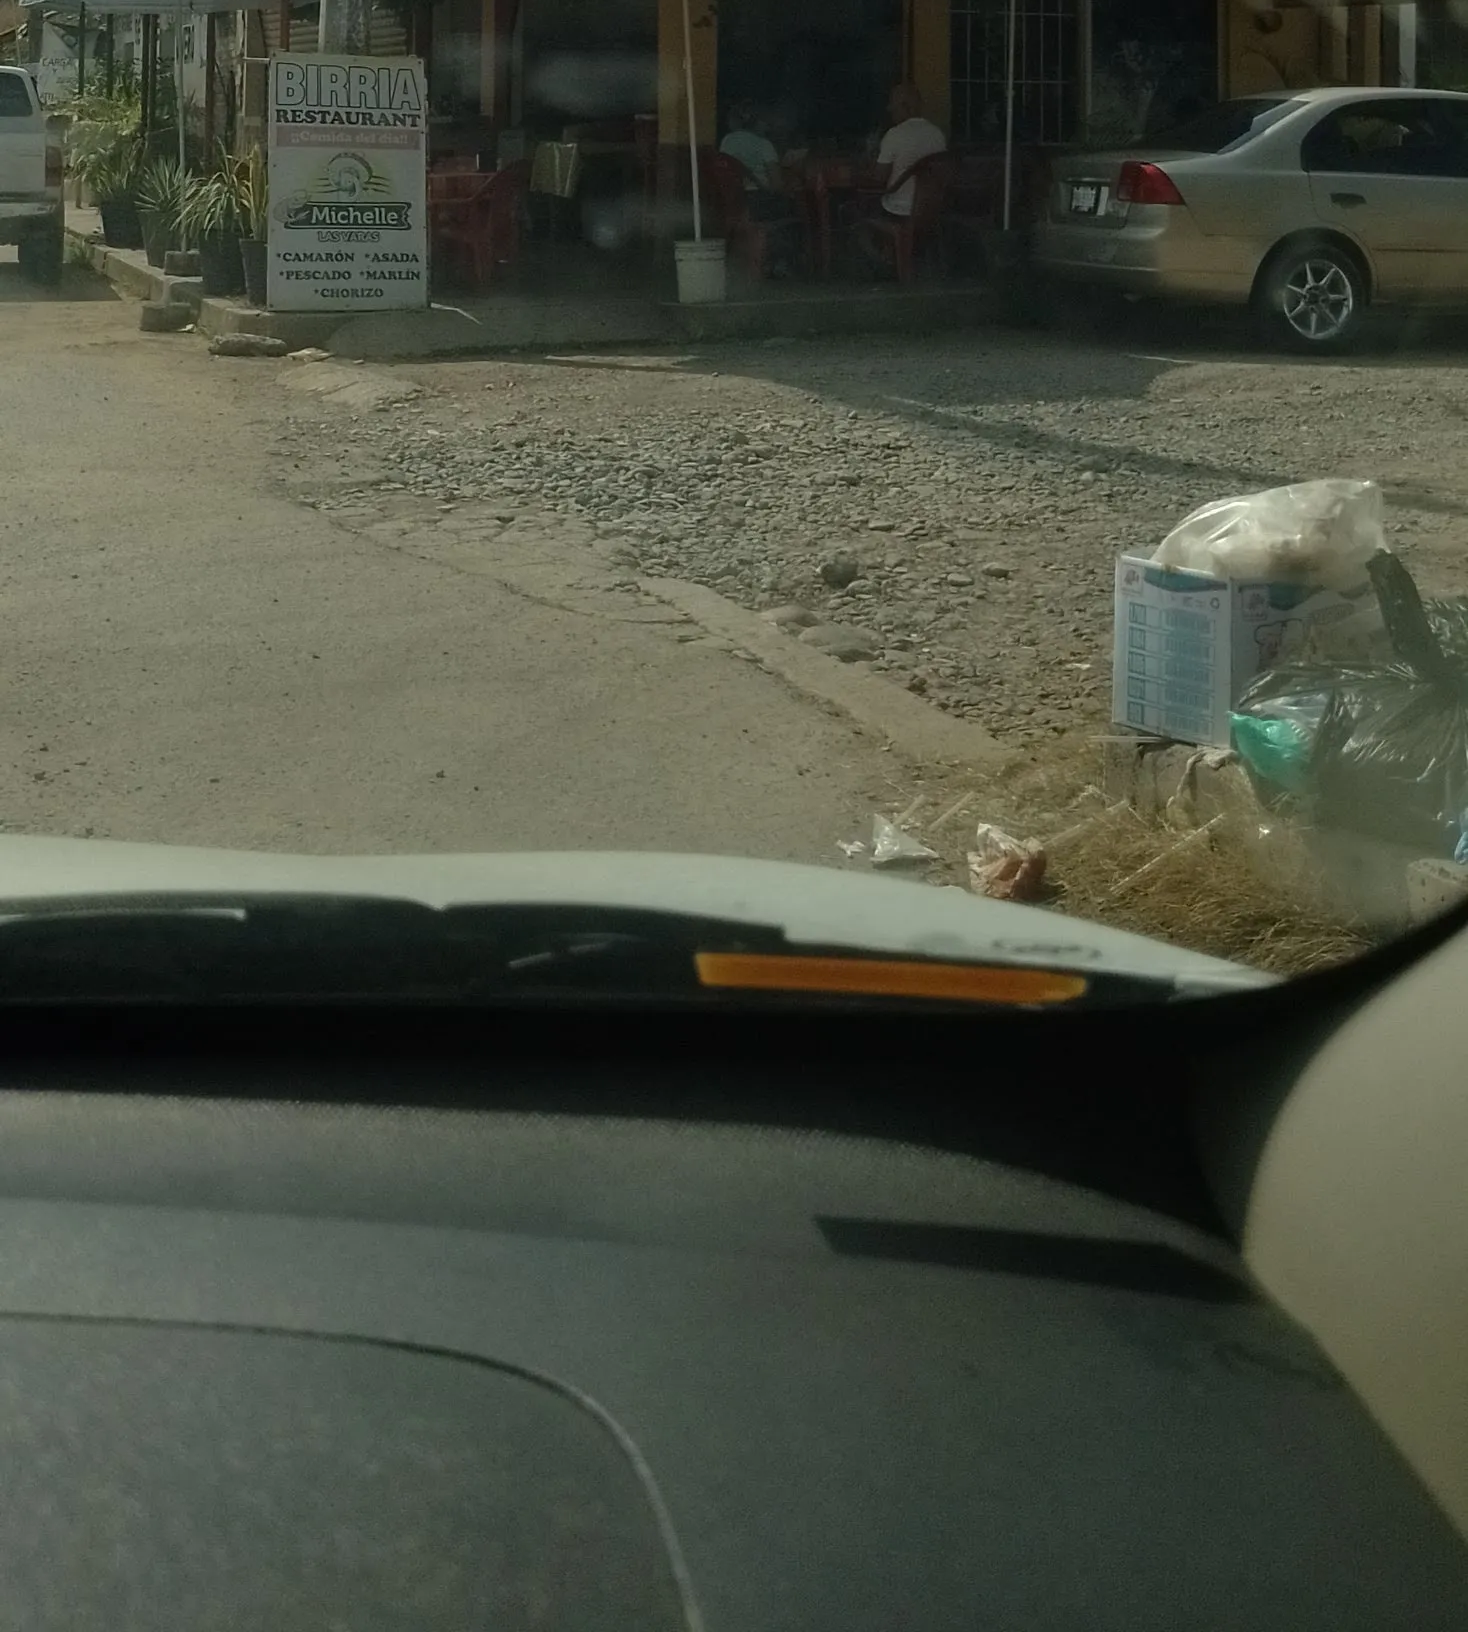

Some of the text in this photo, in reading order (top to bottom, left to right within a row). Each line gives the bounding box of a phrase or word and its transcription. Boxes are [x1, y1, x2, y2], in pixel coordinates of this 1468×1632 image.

[275, 62, 422, 111] BIRRIA
[275, 109, 421, 128] RESTAURANT
[310, 206, 399, 225] Michelle
[317, 230, 341, 243] LAS
